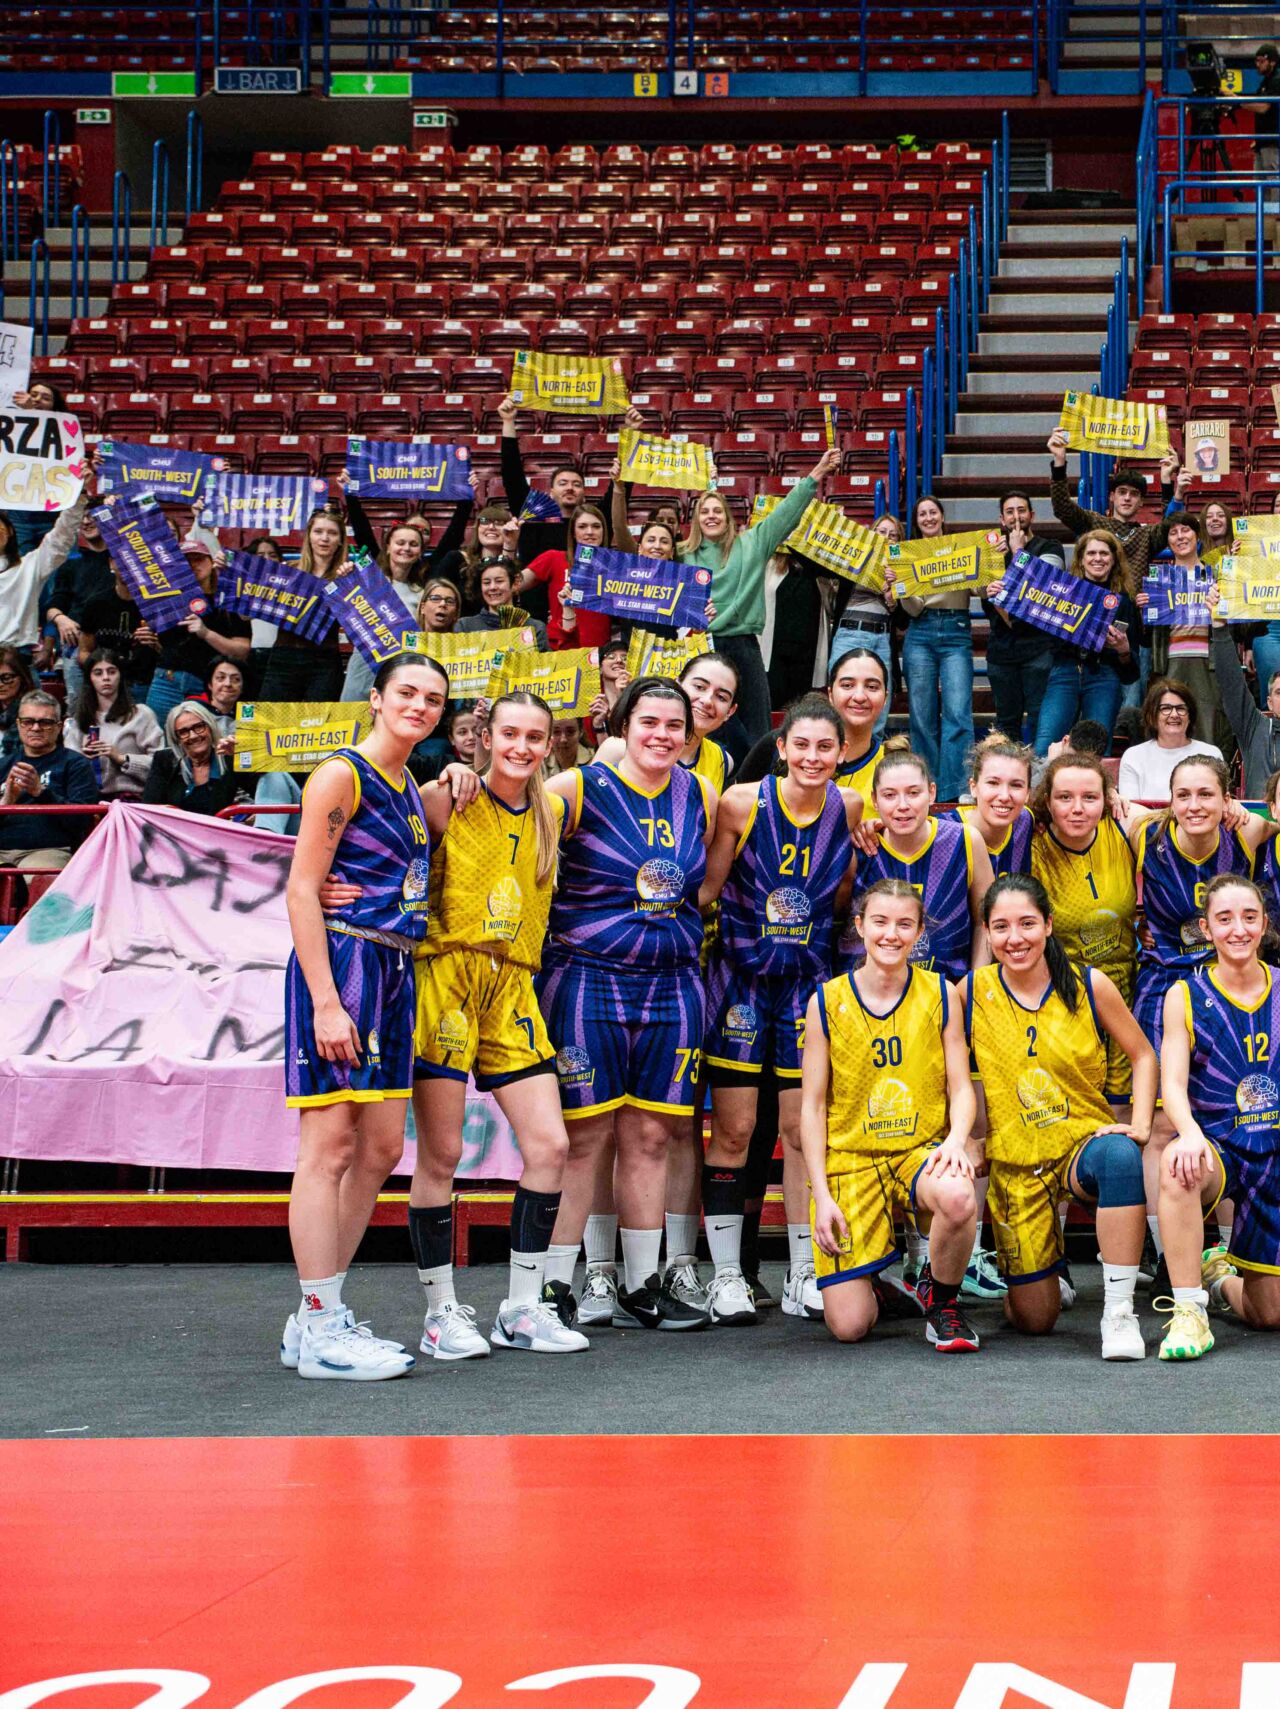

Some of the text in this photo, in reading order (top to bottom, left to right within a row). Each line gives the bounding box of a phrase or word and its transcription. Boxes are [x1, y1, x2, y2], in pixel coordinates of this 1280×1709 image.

[239, 73, 278, 89] BAR
[641, 75, 651, 86] B
[680, 76, 691, 90] 4
[542, 375, 597, 392] NORTH-EAST
[1089, 422, 1142, 436] NORTH-EAST
[1191, 422, 1225, 438] CARRARO
[397, 455, 417, 463] CMU
[638, 453, 692, 467] NORTH-EAST
[130, 468, 193, 484] SOUTH-WEST
[376, 466, 438, 480] SOUTH-WEST
[230, 498, 293, 510] SOUTH-WEST
[811, 528, 865, 561] NORTH-EAST
[125, 530, 171, 590] SOUTH-WEST
[154, 545, 172, 563] CMU
[630, 570, 652, 578] CMU
[920, 555, 972, 576] NORTH-EAST
[269, 575, 289, 585] CMU
[1051, 583, 1069, 594] CMU
[1195, 579, 1213, 587] CMU
[242, 582, 307, 609] SOUTH-WEST
[604, 579, 674, 600] SOUTH-WEST
[1025, 587, 1082, 618] SOUTH-WEST
[1175, 592, 1206, 606] SOUTH-
[380, 604, 398, 622] CMU
[351, 594, 400, 651] SOUTH-WEST
[444, 657, 490, 676] ORTH-EA
[300, 718, 323, 728] CMU
[276, 730, 348, 748] NORTH-EAST
[408, 814, 427, 845] 19
[639, 818, 675, 848] 73
[508, 833, 519, 866] 7
[779, 843, 811, 878] 21
[1084, 871, 1099, 900] 1
[766, 925, 807, 936] SOUTH-WEST
[1084, 932, 1120, 957] NORTH-EAST
[436, 1034, 466, 1047] NORTH-EAST
[515, 1017, 536, 1051] 7
[1026, 1025, 1037, 1057] 2
[871, 1035, 902, 1068] 30
[1243, 1032, 1269, 1063] 12
[675, 1047, 700, 1084] 73
[1026, 1103, 1065, 1123] NORTH-EAST
[1238, 1110, 1280, 1125] SOUTH-WEST
[868, 1117, 913, 1131] NORTH-EAST
